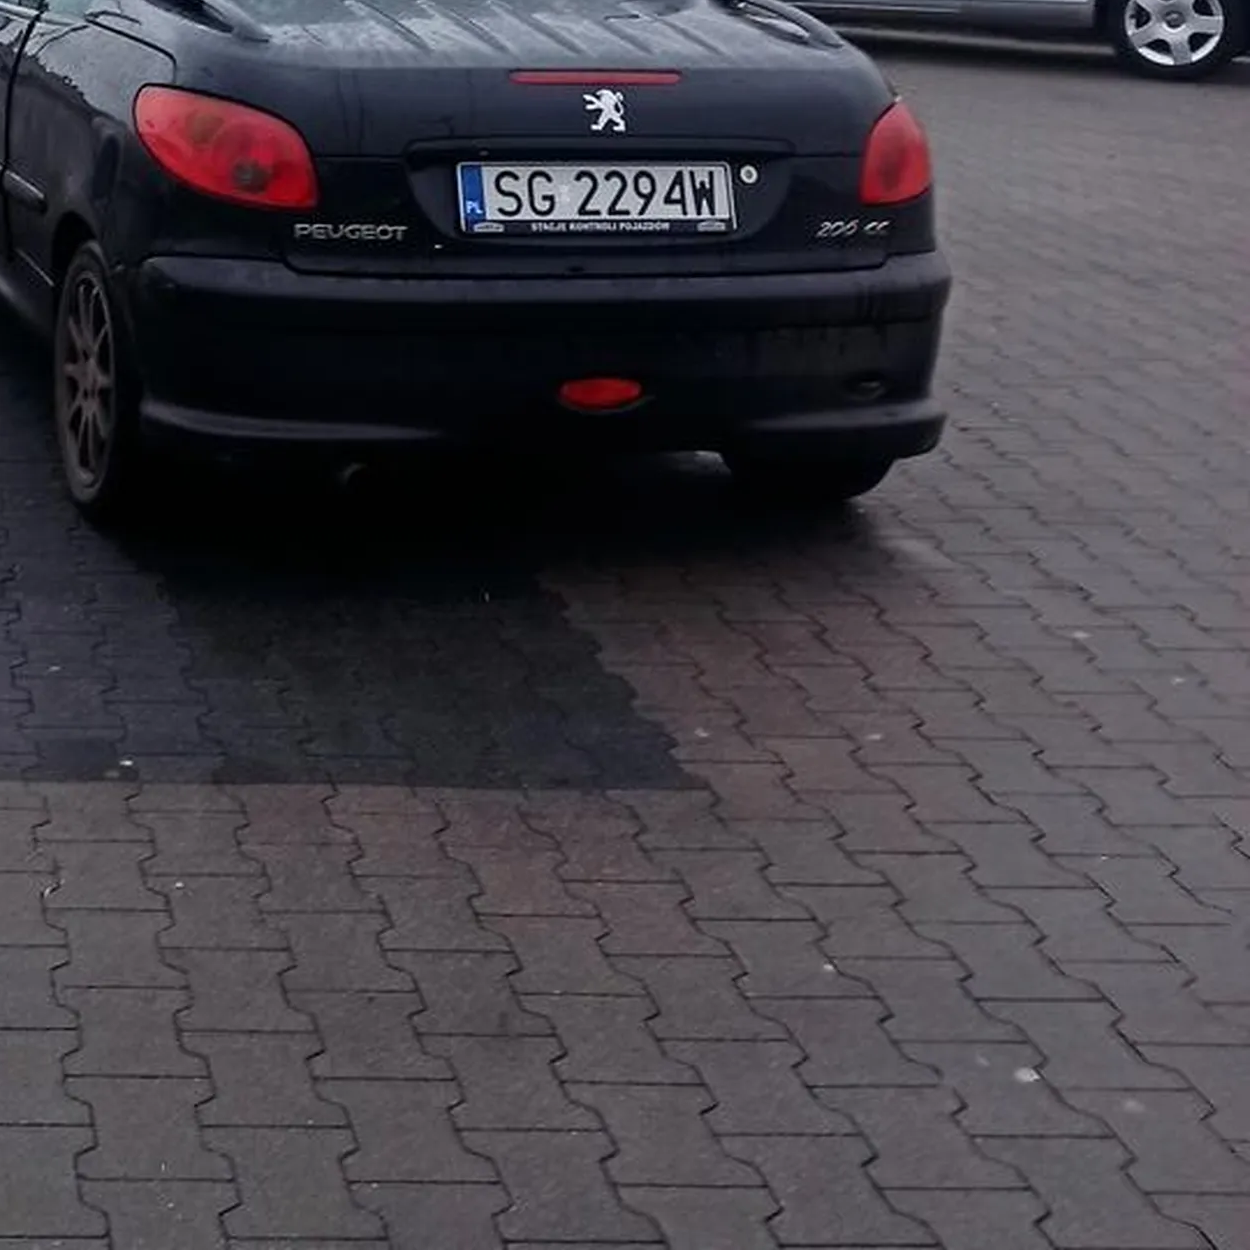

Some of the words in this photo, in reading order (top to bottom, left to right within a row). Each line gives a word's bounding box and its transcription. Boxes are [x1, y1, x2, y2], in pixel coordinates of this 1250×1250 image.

[494, 170, 556, 217] SG
[573, 170, 716, 217] 2294W
[466, 201, 483, 215] PL
[294, 223, 409, 241] PEUGEOT
[569, 221, 617, 232] KONTROLI
[618, 220, 670, 232] POJAZDÓW
[815, 219, 860, 238] 206
